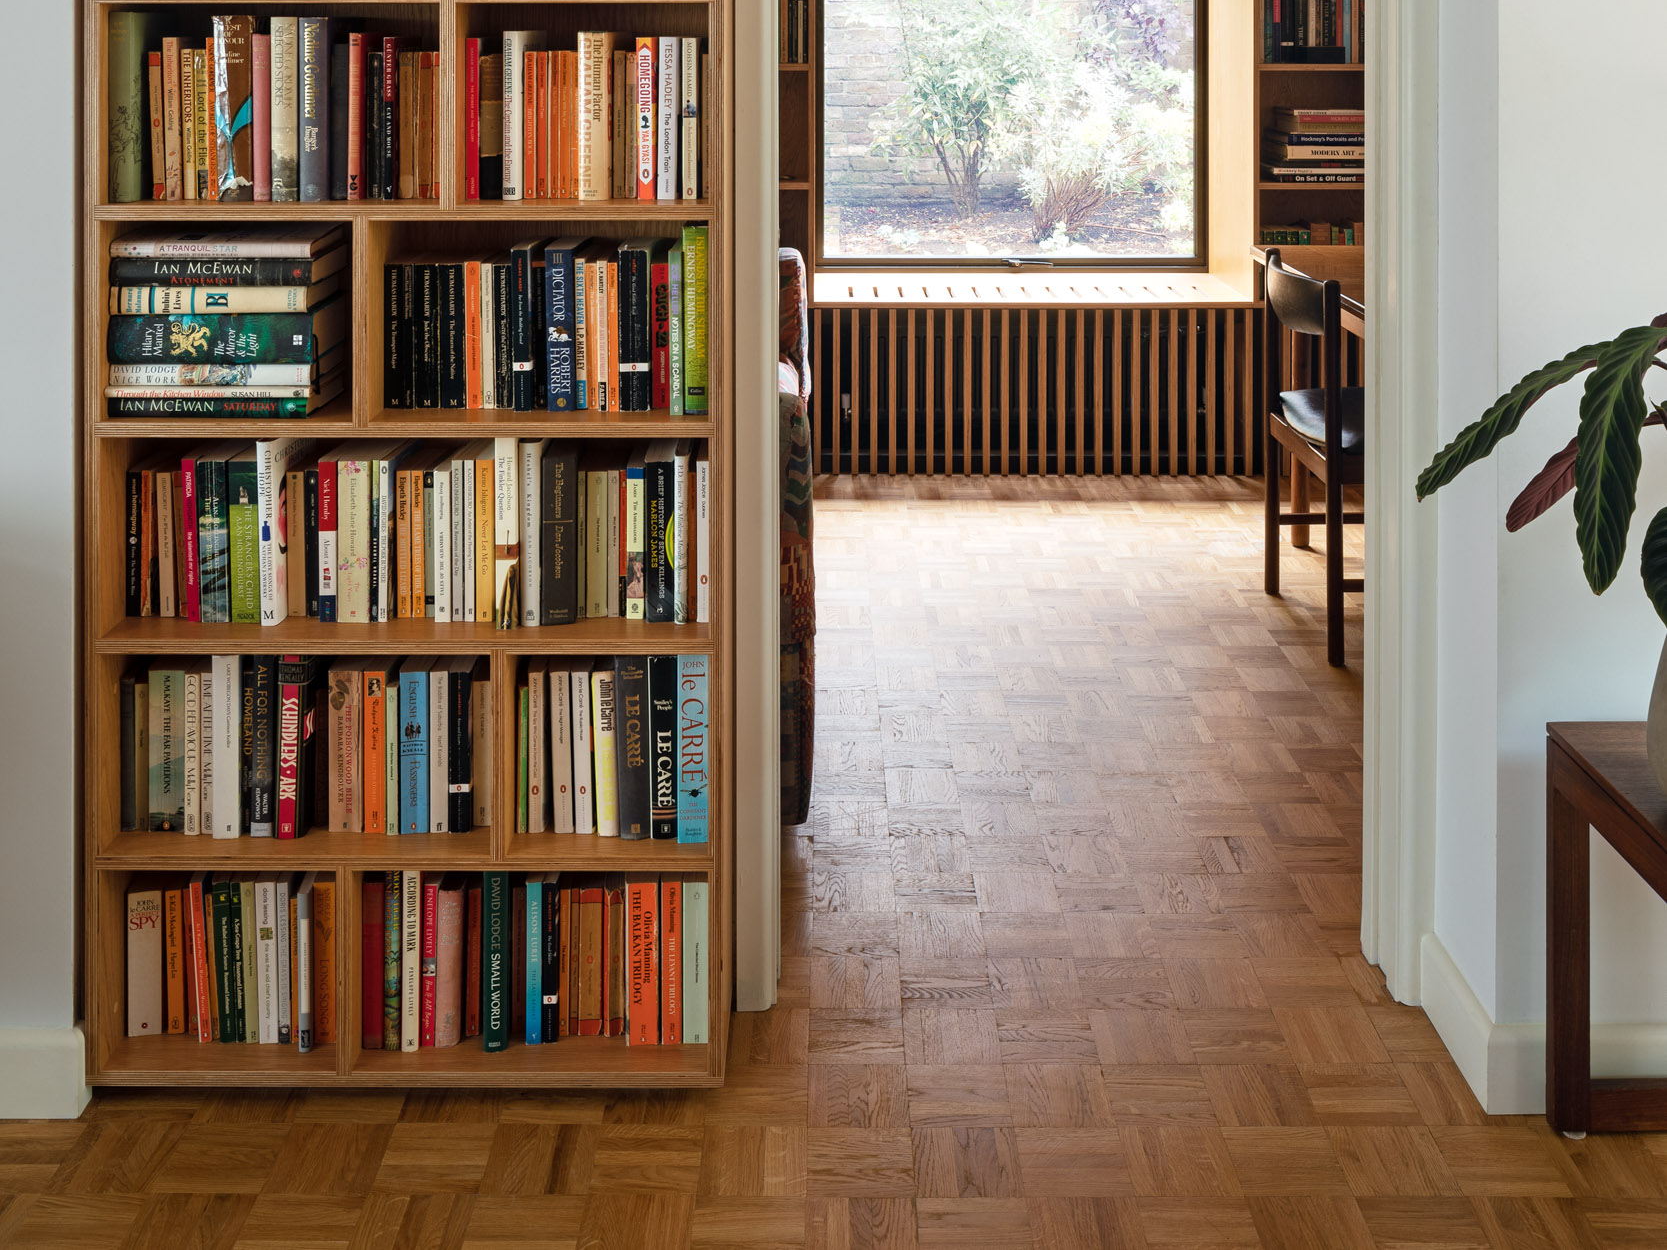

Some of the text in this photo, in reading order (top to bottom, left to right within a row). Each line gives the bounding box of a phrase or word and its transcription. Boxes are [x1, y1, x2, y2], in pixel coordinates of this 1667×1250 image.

[183, 51, 191, 68] THE
[274, 25, 283, 106] SELECTED STORIES
[304, 22, 319, 119] Nadine Gordimer
[592, 38, 603, 121] The Human Factor
[184, 71, 192, 123] INHERITORS
[639, 54, 650, 163] HOMEGOING YAA GYASI
[664, 43, 673, 173] TESSA HADLEY The London Train
[154, 261, 180, 275] IAN
[170, 276, 235, 285] ATONEMENT
[552, 268, 565, 320] DICTATOR
[686, 245, 695, 351] ERNEST HEMINGWAY
[113, 366, 177, 374] DAVID LODGE
[142, 327, 154, 356] Hilary
[152, 323, 164, 356] Mantel
[214, 340, 224, 356] The
[225, 327, 236, 357] Mirror
[236, 333, 245, 346] the
[247, 333, 256, 356] Light
[550, 347, 559, 394] HARRIS
[560, 347, 570, 394] ROBERT
[113, 376, 177, 384] NICE WORK
[120, 398, 146, 411] IAN
[223, 402, 278, 411] SATURDAY
[184, 471, 193, 497] PATRICIA
[258, 472, 267, 497] HOPE
[265, 450, 274, 519] CHRISTOPHER
[321, 478, 330, 521] Nick Hornby
[497, 456, 507, 519] The Finkler Question
[349, 477, 358, 556] Elizabeth Jane Howard
[650, 500, 659, 568] MARLON JAMES
[244, 504, 254, 608] THE STRANGER'S CHILD
[682, 661, 705, 669] JOHN
[243, 687, 253, 755] HOMELAND
[256, 664, 268, 779] ALL FOR NOTHING
[280, 697, 299, 801] SCHINDLER'S ARK
[625, 694, 645, 768] LE CARRÉ
[681, 672, 707, 783] le CARRÉ
[656, 730, 675, 808] LE CARRÉ
[129, 915, 161, 931] SPY
[406, 876, 417, 952] ACCORDING TO MARK
[425, 888, 434, 954] PENELOPE LIVELY
[531, 901, 540, 963] ALISON LURIE
[491, 877, 500, 1029] DAVID LODGE SMALL WORLD
[632, 889, 642, 1005] THE BALKAN TRILOGY
[643, 910, 653, 983] Olivia Manning
